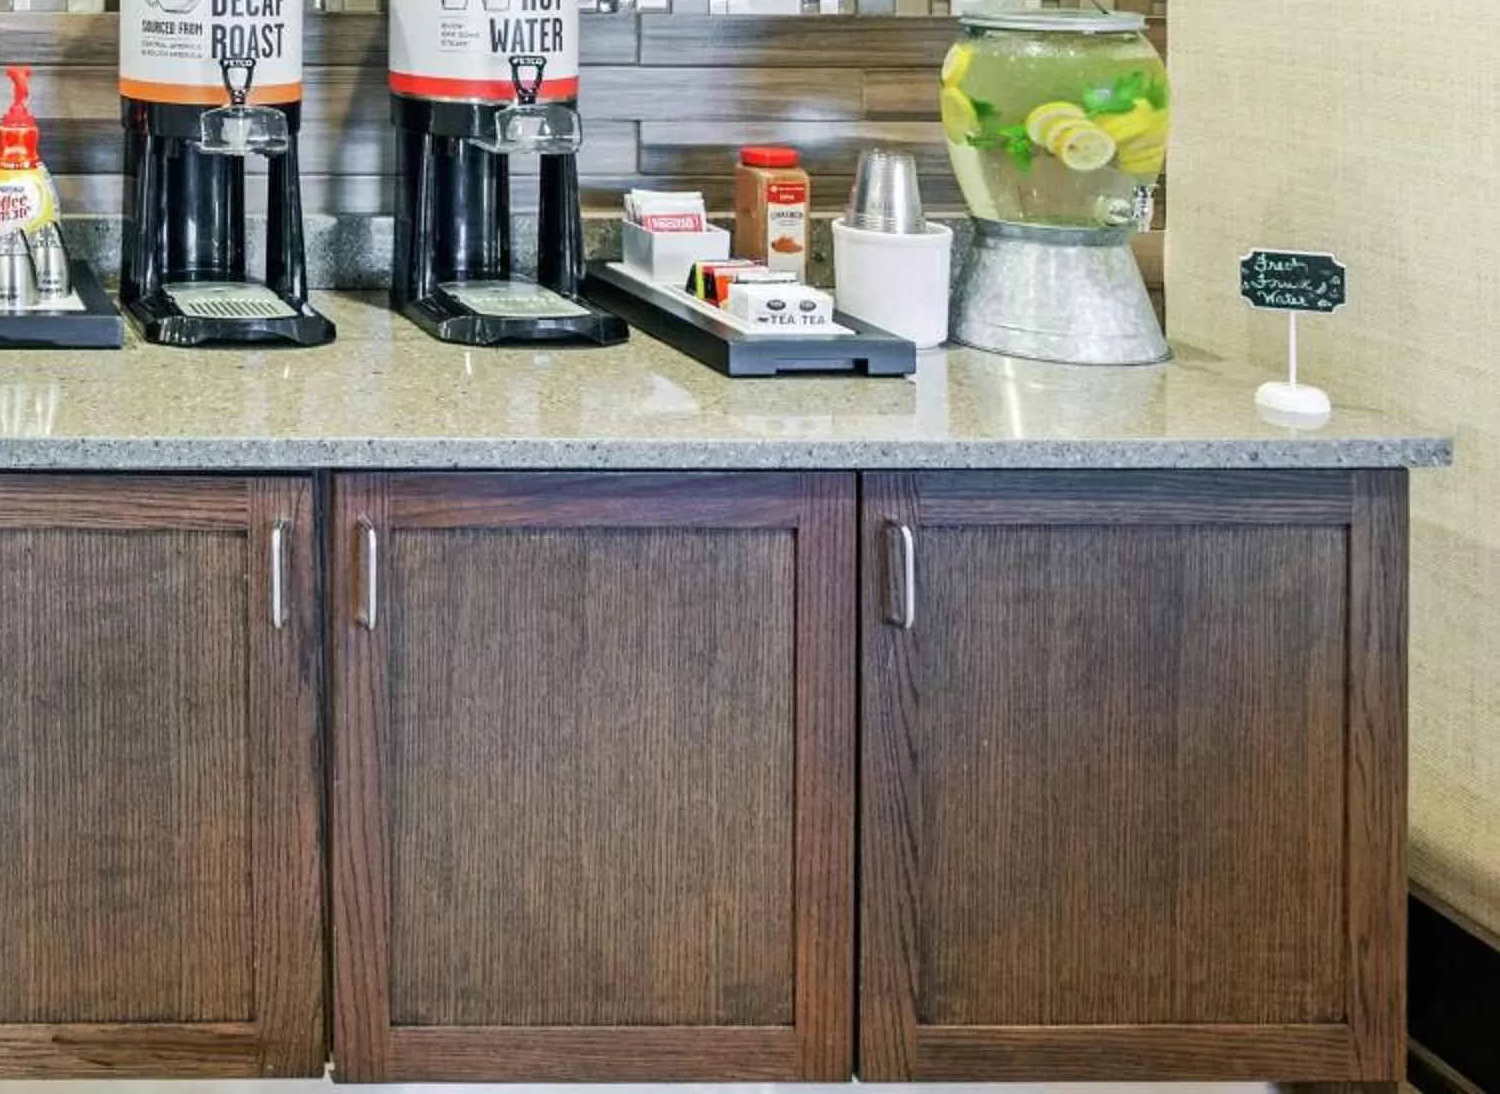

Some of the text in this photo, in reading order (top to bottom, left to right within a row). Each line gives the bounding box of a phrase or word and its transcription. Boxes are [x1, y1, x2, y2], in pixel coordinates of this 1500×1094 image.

[489, 17, 564, 53] WATER
[211, 23, 285, 59] ROAST
[223, 59, 254, 67] FETCO
[771, 314, 796, 325] TEA
[801, 315, 826, 325] TEA
